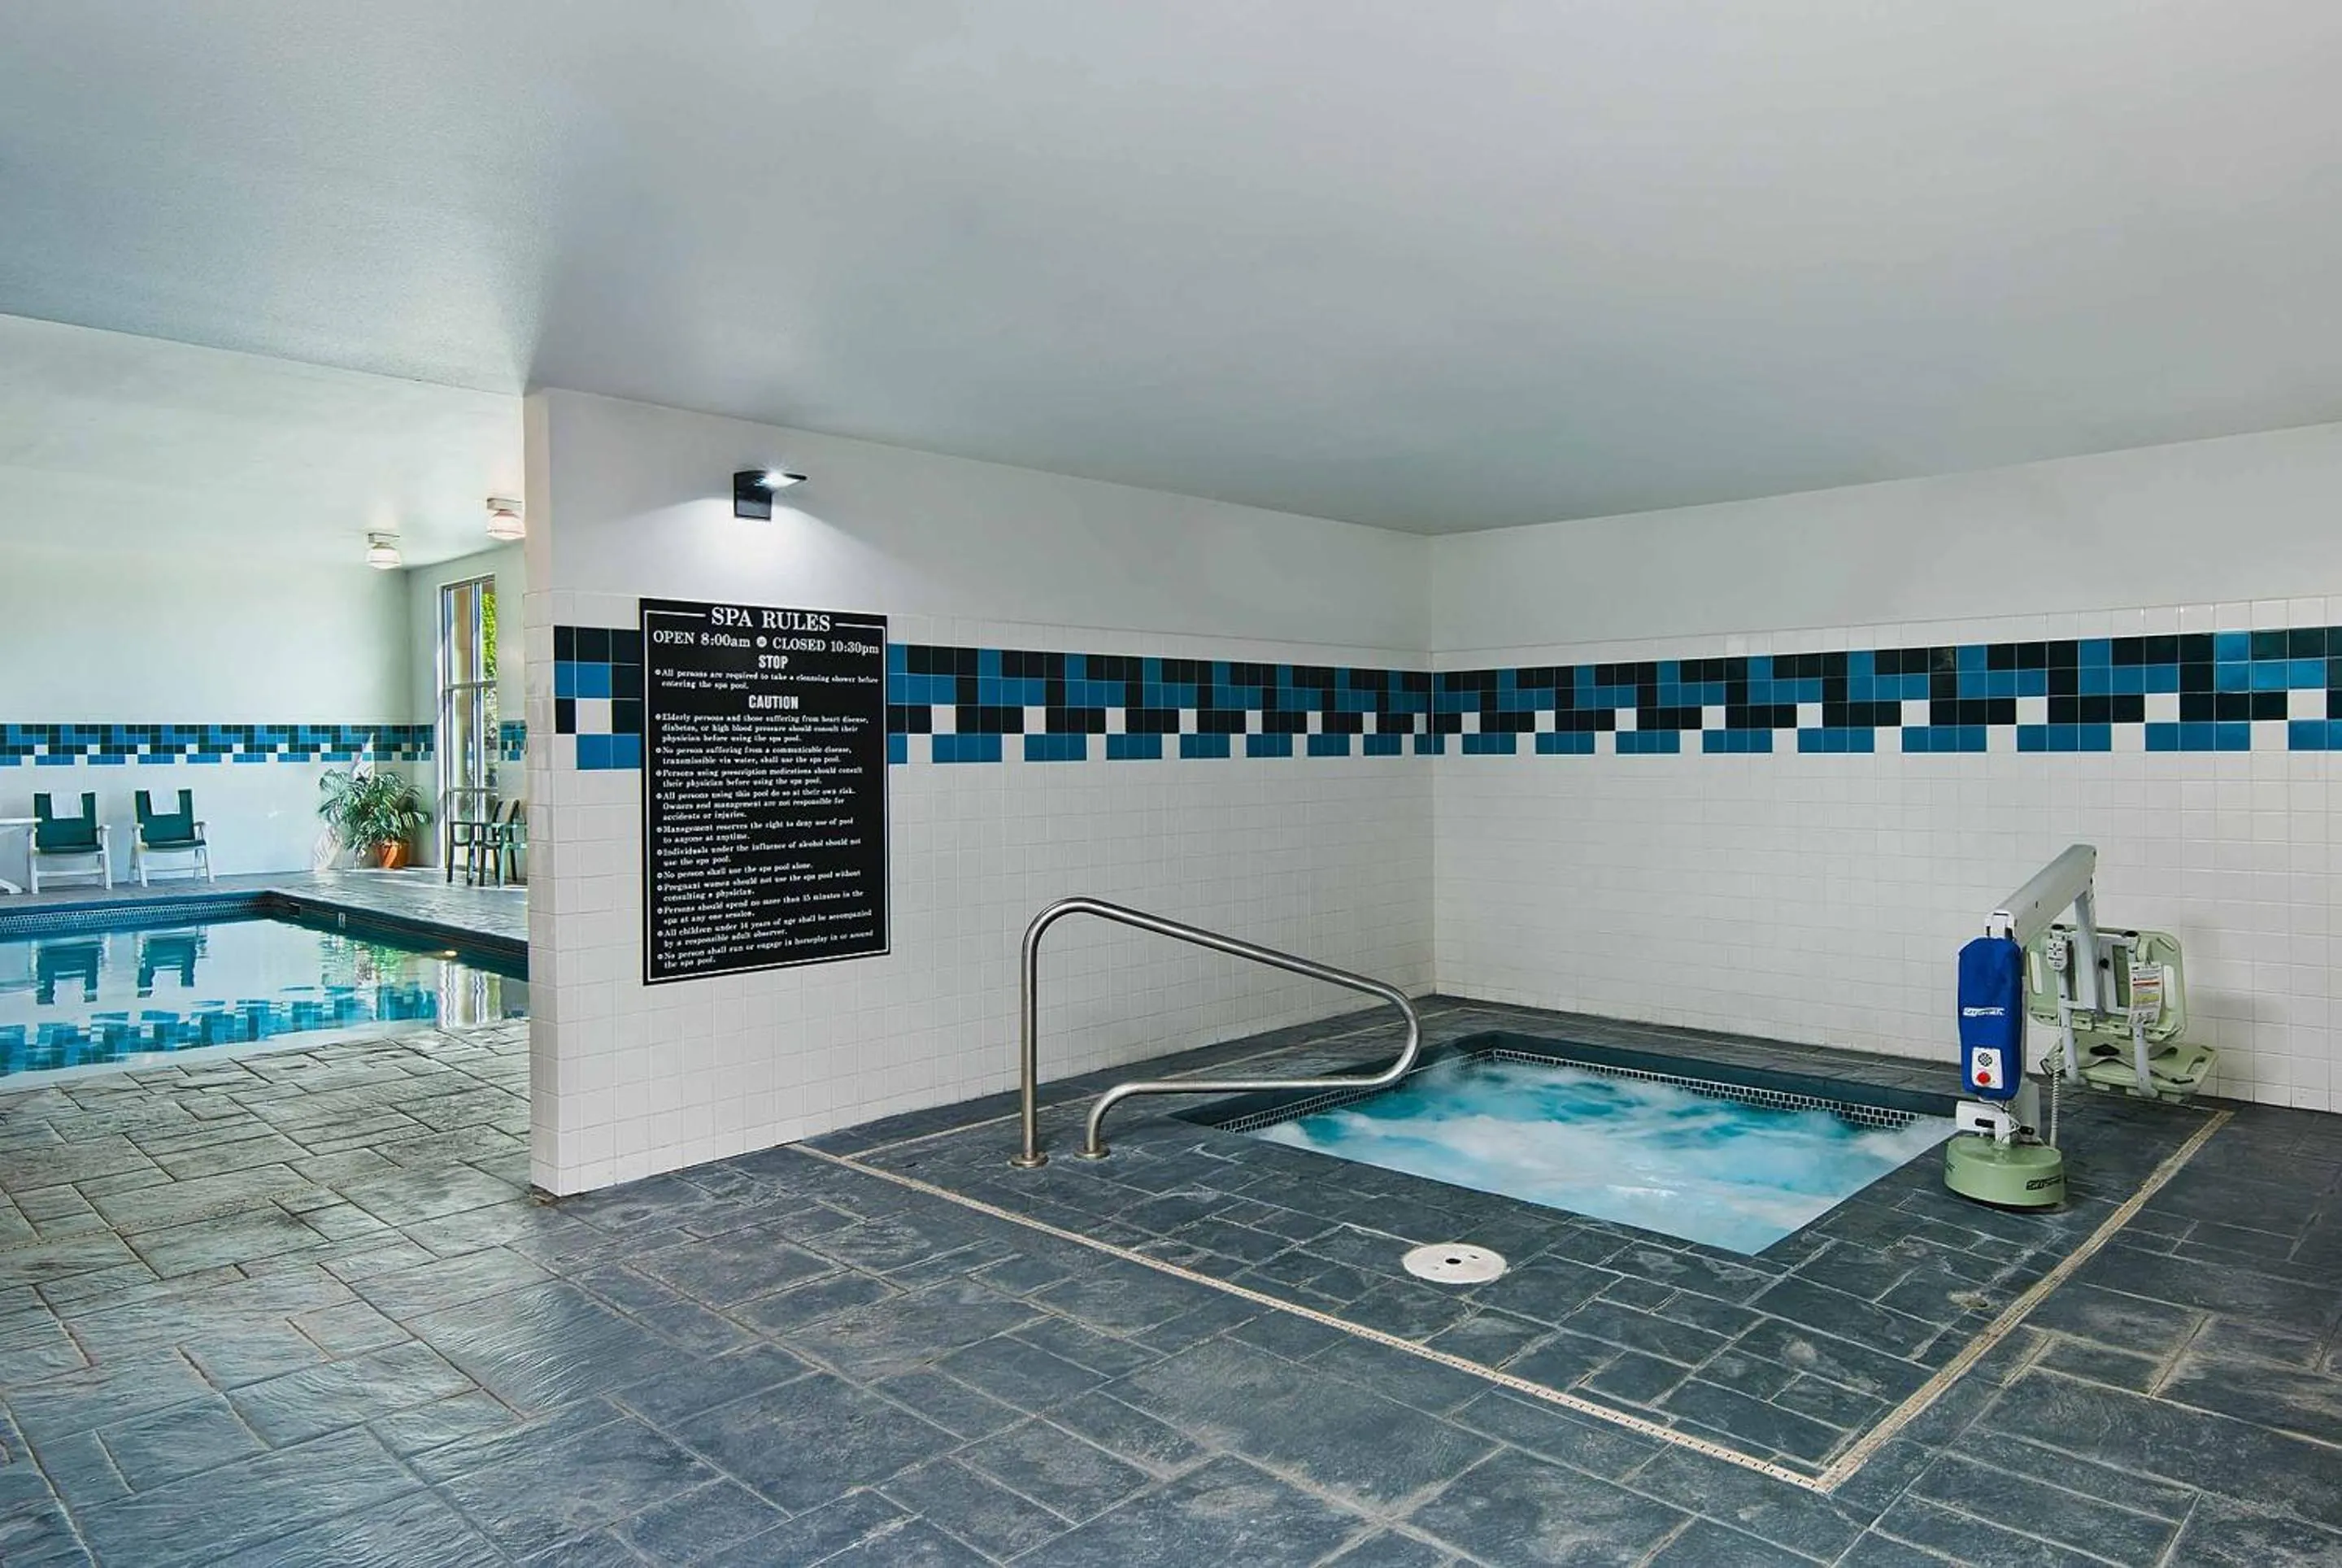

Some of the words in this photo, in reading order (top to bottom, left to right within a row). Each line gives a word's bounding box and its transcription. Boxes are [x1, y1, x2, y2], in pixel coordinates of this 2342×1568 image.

[711, 606, 751, 627] SPA
[762, 610, 830, 632] RULES
[653, 629, 694, 644] OPEN
[700, 633, 750, 647] 8:00am
[773, 636, 825, 651] CLOSED
[831, 641, 878, 656] 10:30pm
[758, 654, 787, 669] STOP
[677, 670, 707, 679] persons
[729, 682, 749, 690] pool.
[748, 695, 798, 709] CAUTION
[765, 715, 799, 723] suffering
[662, 734, 700, 743] physician
[730, 734, 751, 743] using
[783, 734, 801, 743] pool.
[705, 747, 742, 755] suffering
[823, 756, 840, 764] pool.
[697, 769, 718, 777] using
[686, 779, 723, 788] physician
[752, 778, 773, 786] using
[804, 777, 821, 785] pool.
[677, 792, 708, 800] persons
[711, 791, 733, 799] using
[712, 856, 730, 865] pool.
[677, 870, 704, 879] person
[759, 865, 772, 873] spa
[663, 917, 677, 926] spa
[677, 949, 704, 960] person
[664, 960, 677, 969] the
[680, 960, 694, 969] spa
[696, 956, 715, 966] pool.
